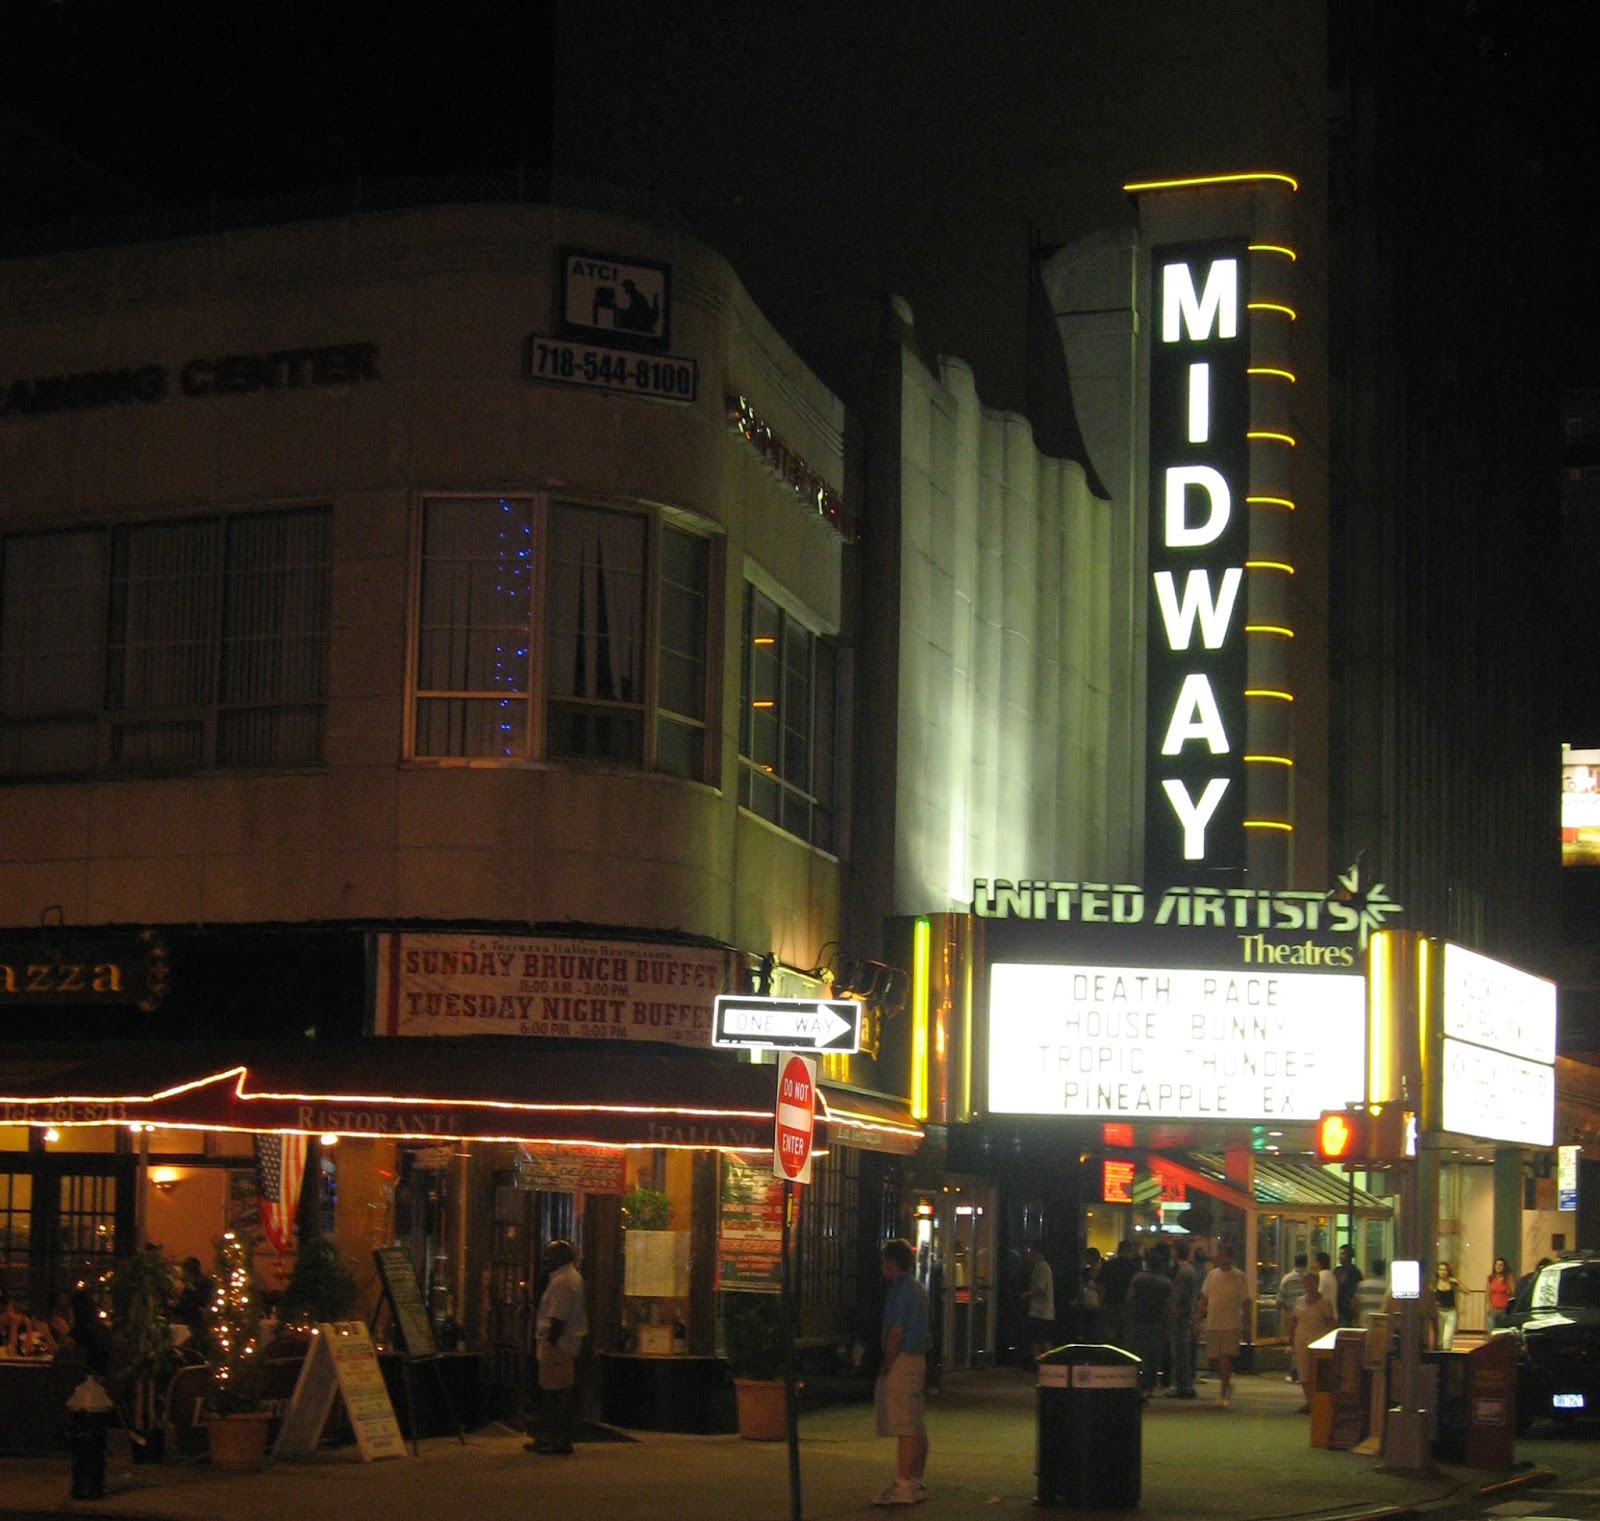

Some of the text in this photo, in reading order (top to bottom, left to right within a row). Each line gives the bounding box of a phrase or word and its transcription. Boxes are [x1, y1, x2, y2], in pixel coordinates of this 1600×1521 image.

[573, 261, 618, 281] ATCI
[537, 344, 689, 394] 718-544-8100
[1153, 258, 1244, 861] MIDWAY
[974, 877, 1360, 932] UNITED ARTISTS
[1238, 934, 1354, 967] Theatres
[406, 950, 718, 988] SUNDAY BRUNCH BUFFET
[1073, 973, 1279, 1006] DEATH RACE
[406, 991, 533, 1019] TUESDAY
[542, 996, 627, 1023] NIGHT
[736, 1013, 835, 1034] ONE WAY
[1066, 1010, 1157, 1039] HOUSE
[1038, 1045, 1144, 1074] TROPIC
[784, 1077, 809, 1102] DO NOT
[1064, 1081, 1294, 1112] PINEAPPLE EX
[782, 1133, 804, 1157] ENTER
